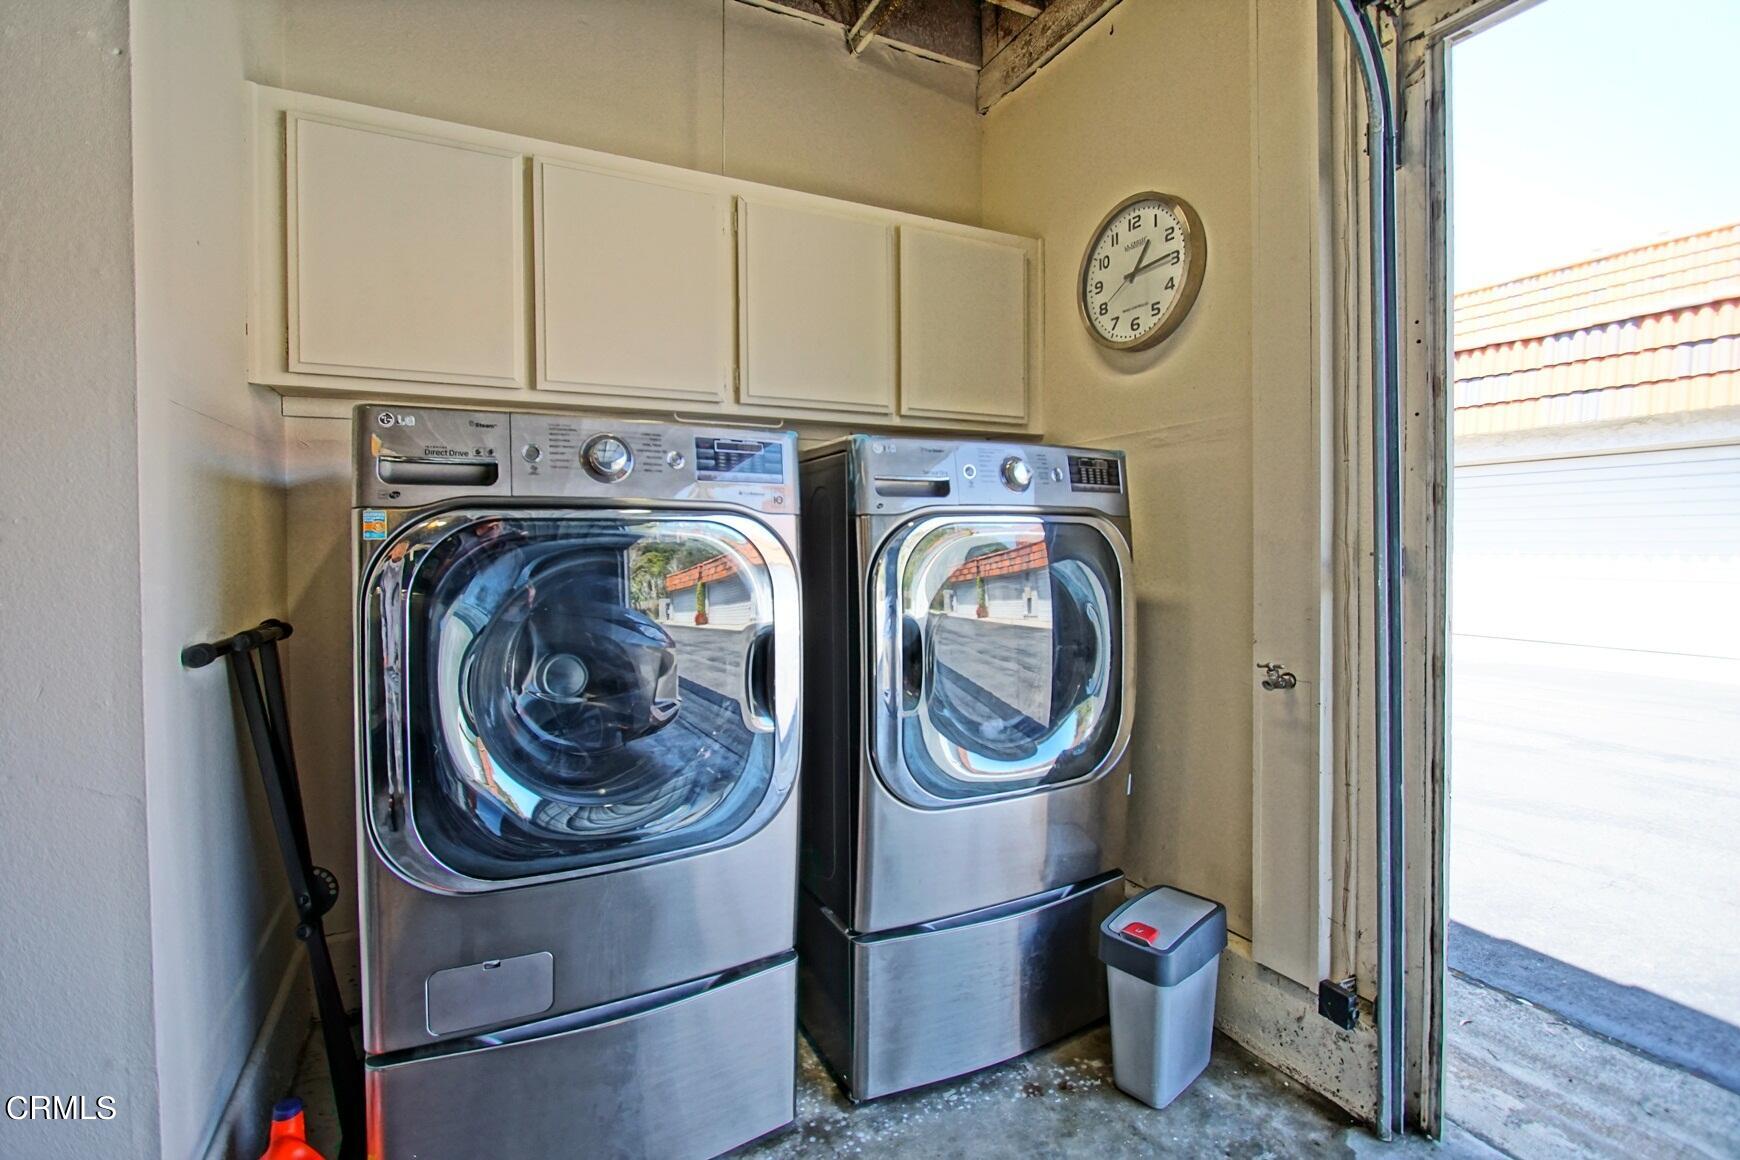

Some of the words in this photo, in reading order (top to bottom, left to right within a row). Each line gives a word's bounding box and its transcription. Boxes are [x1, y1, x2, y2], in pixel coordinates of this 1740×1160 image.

[1128, 214, 1142, 232] 12
[1153, 213, 1158, 228] 1
[1111, 232, 1119, 248] 11
[1165, 226, 1175, 242] 2
[1098, 255, 1110, 271] 10
[1170, 249, 1181, 266] 3
[1094, 281, 1104, 295] 9
[1164, 276, 1176, 291] 4
[1099, 302, 1109, 316] 8
[1151, 301, 1161, 317] 5
[1111, 316, 1120, 331] 7
[1130, 317, 1141, 332] 6
[396, 414, 416, 426] LG
[424, 448, 448, 456] Direct
[449, 449, 469, 457] Drive
